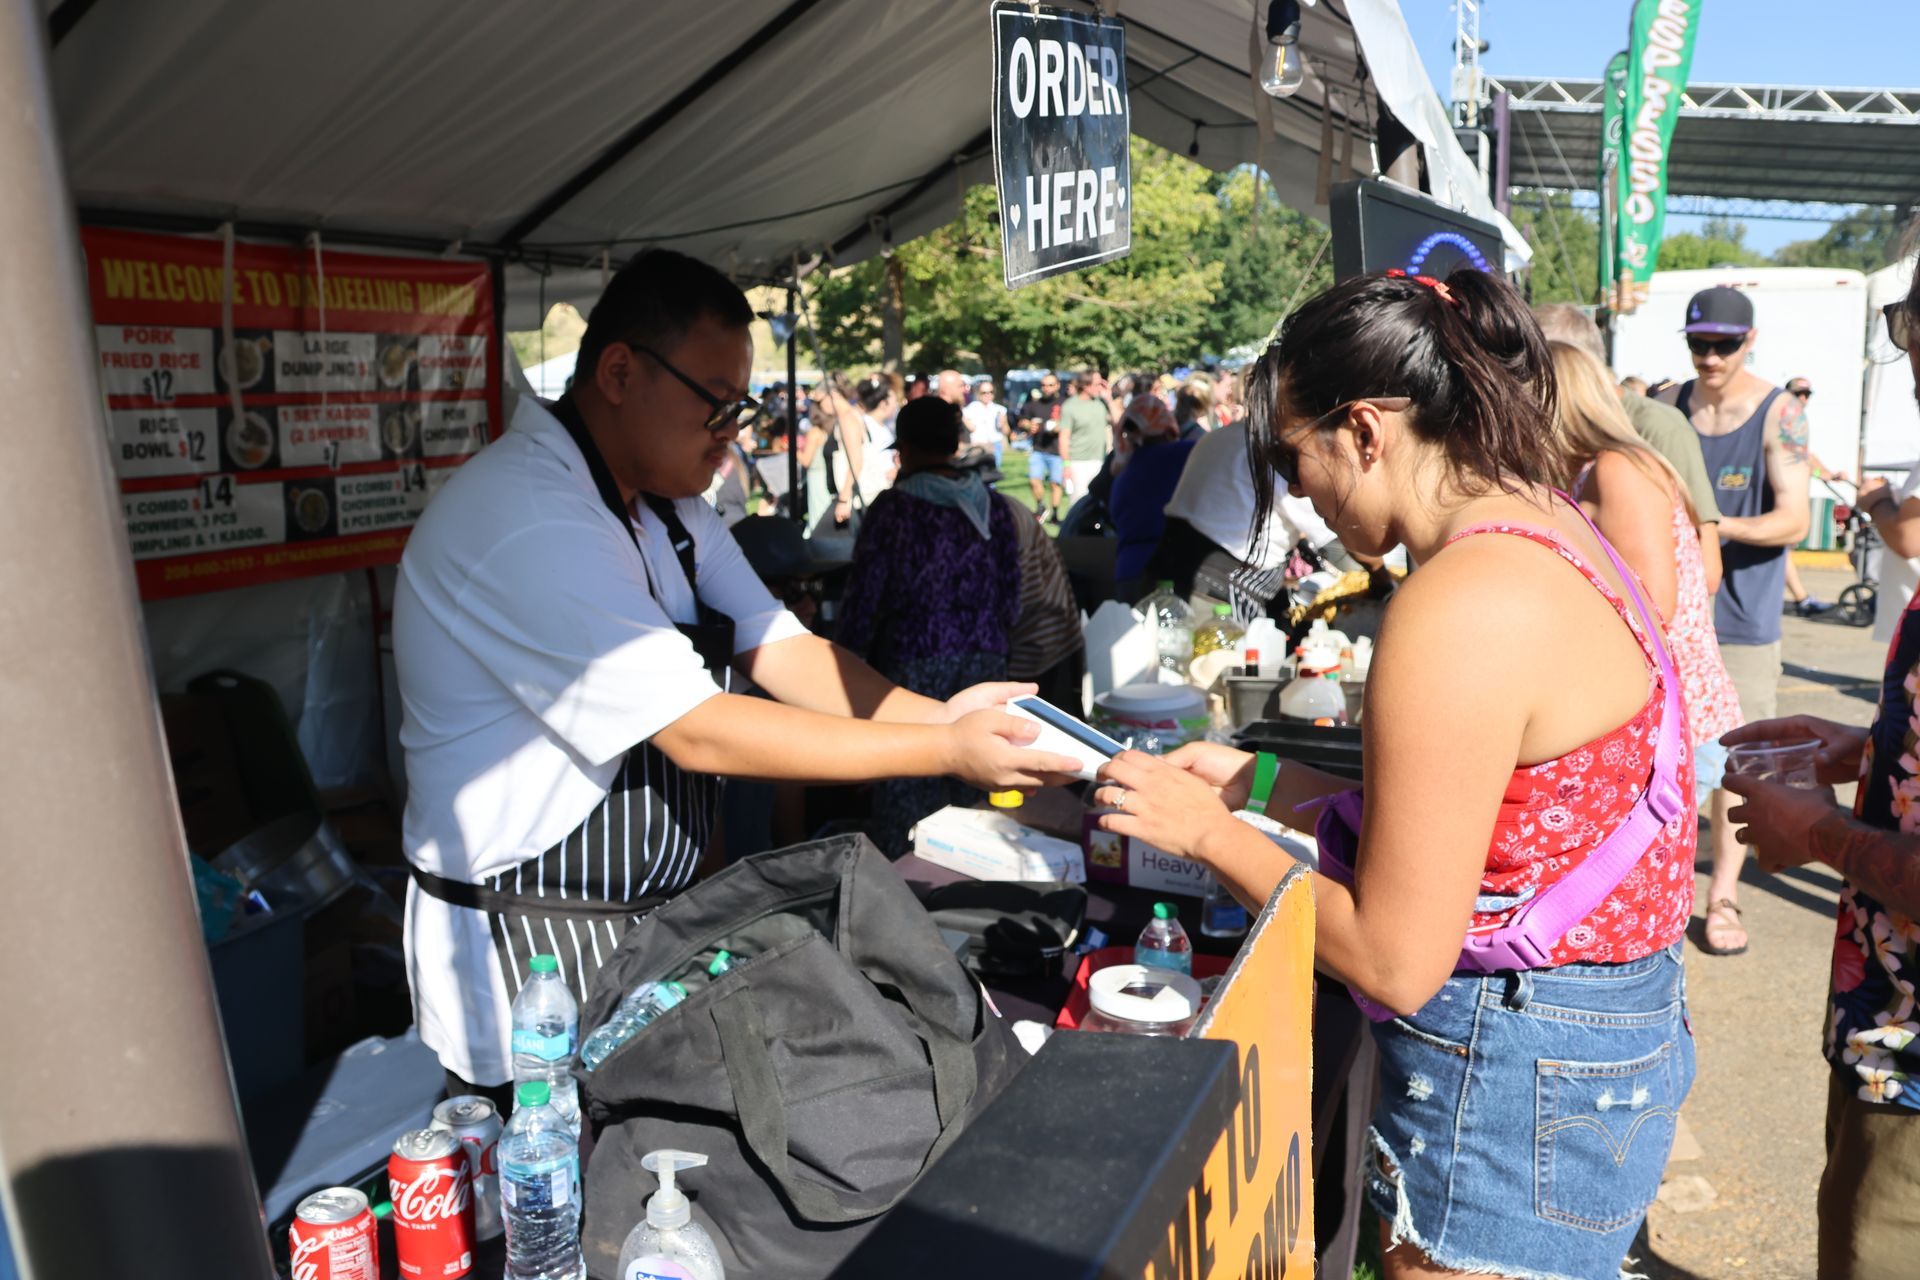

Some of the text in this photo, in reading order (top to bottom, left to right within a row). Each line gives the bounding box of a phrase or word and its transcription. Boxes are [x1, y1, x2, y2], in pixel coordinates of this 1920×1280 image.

[1009, 37, 1122, 118] ORDER
[1026, 166, 1116, 251] HERE
[102, 257, 245, 304] WELCOME
[244, 270, 282, 306] TO
[283, 273, 414, 314] DARJEELING
[122, 328, 175, 344] PORK
[102, 352, 200, 369] FRIED RICE
[139, 418, 180, 434] RICE
[122, 443, 174, 460] BOWL
[137, 498, 189, 514] COMBO
[212, 513, 238, 525] PCS
[195, 534, 204, 546] &
[1142, 851, 1206, 881] Heavy
